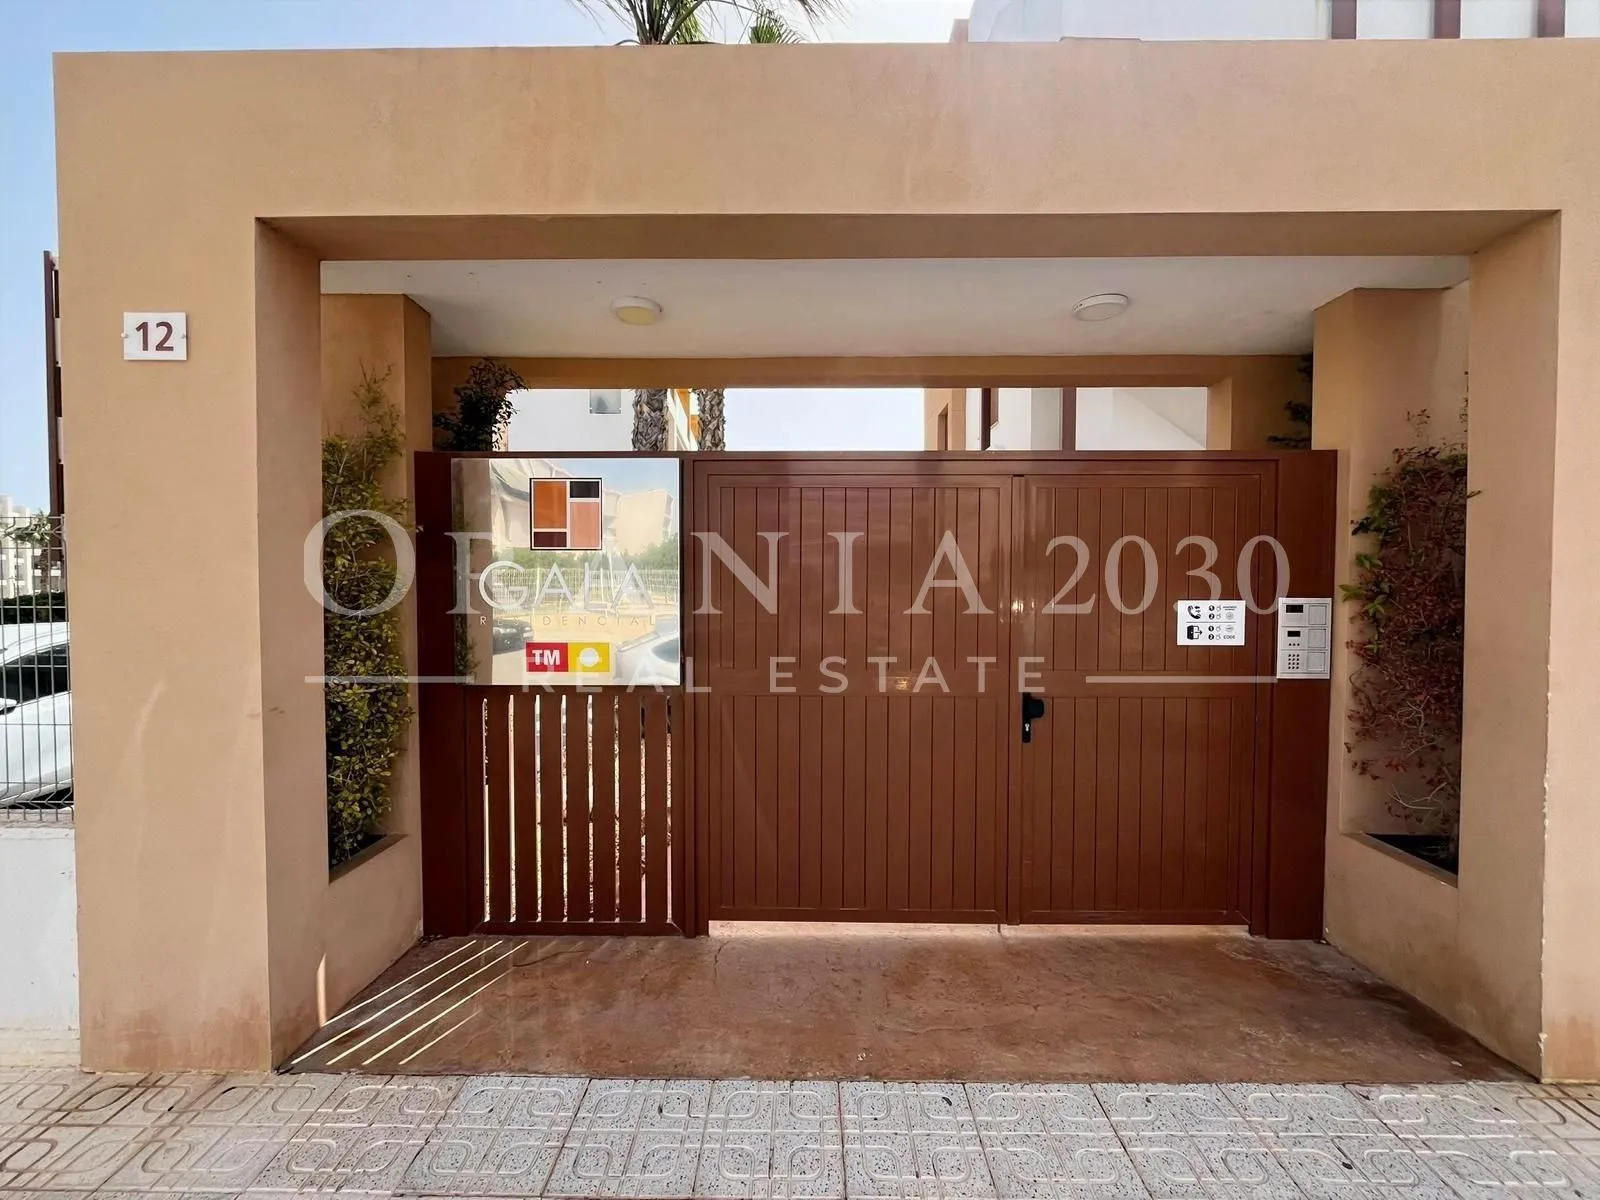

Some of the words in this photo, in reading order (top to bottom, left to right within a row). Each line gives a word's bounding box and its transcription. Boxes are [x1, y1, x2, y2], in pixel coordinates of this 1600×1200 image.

[135, 321, 174, 351] 12
[479, 560, 655, 610] GALA
[532, 650, 560, 665] TM
